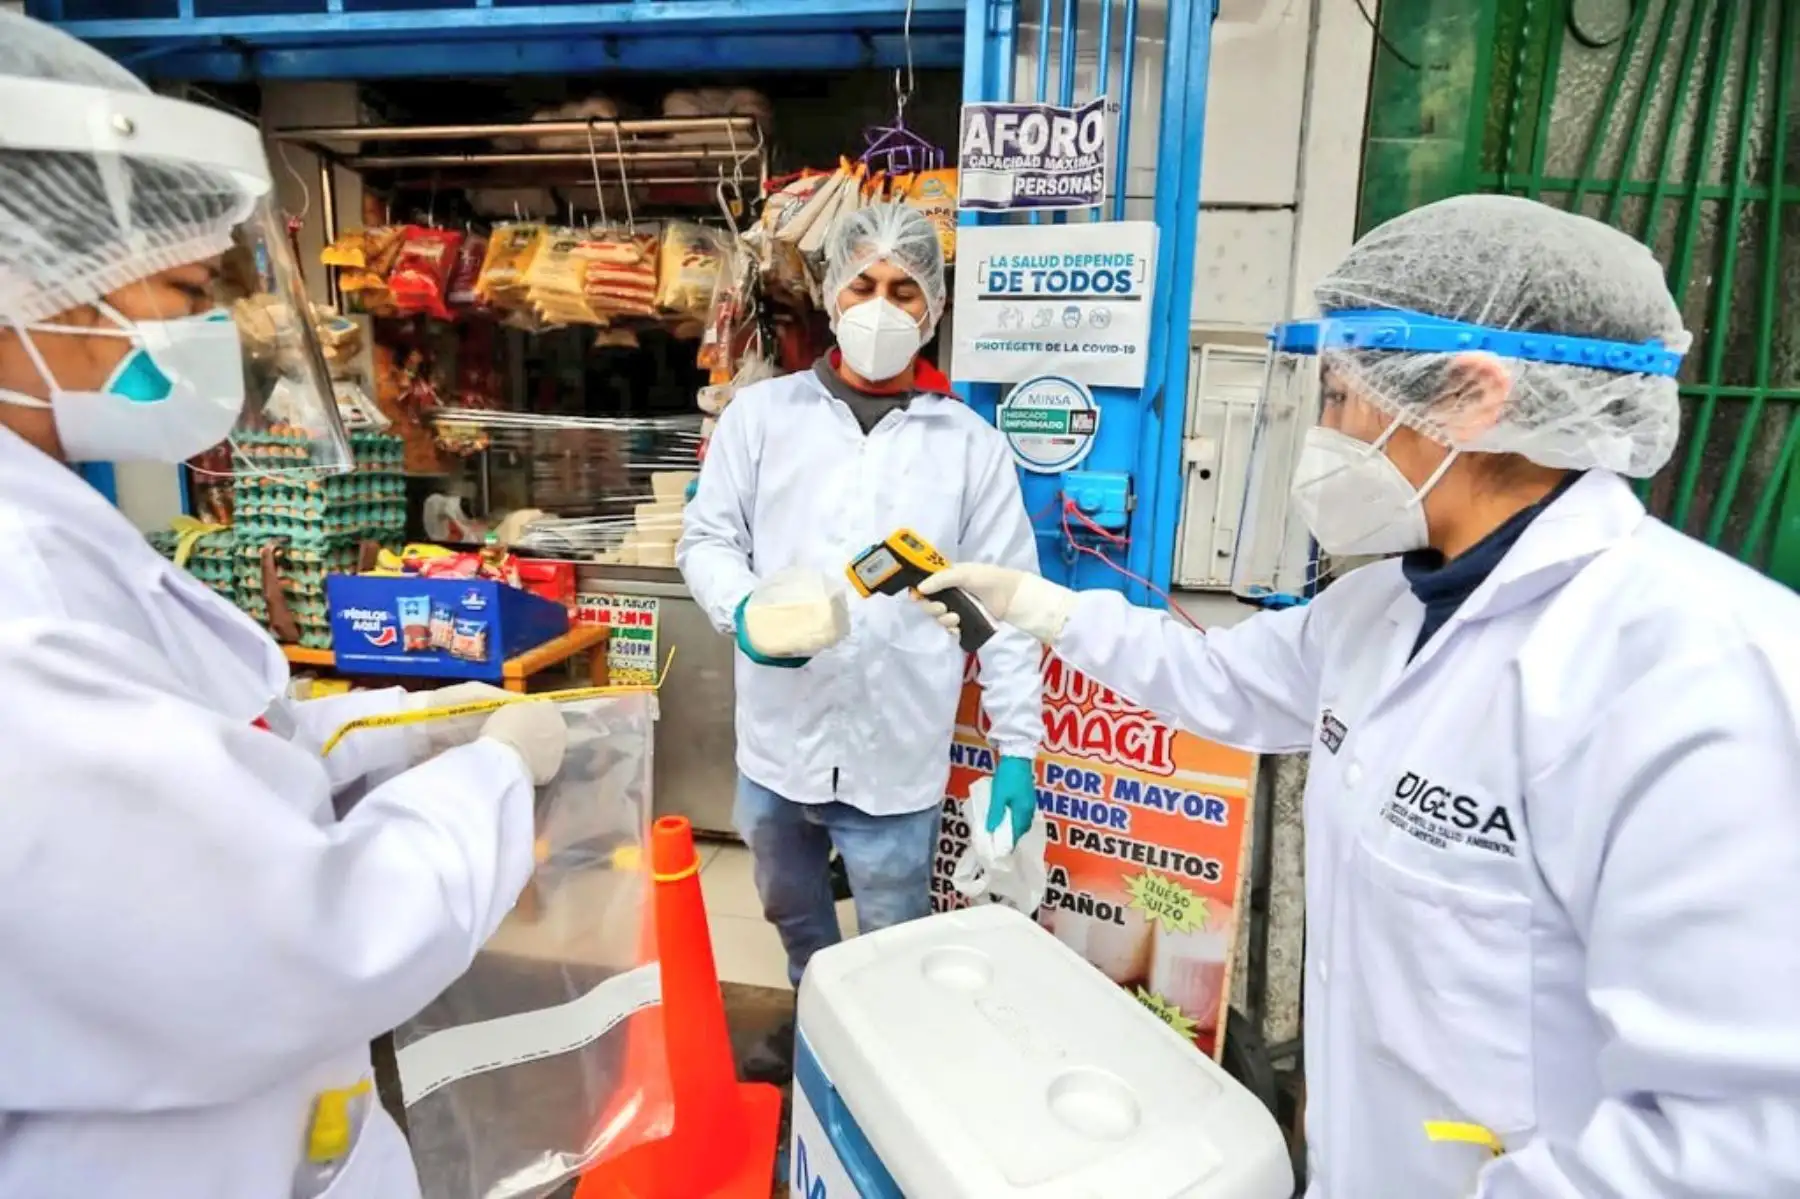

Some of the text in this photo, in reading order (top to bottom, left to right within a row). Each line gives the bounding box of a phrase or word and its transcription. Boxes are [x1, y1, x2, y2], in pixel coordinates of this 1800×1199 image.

[964, 110, 1103, 157] AFORO
[969, 154, 1041, 169] CAPACIDAD
[1015, 172, 1103, 195] PERSONAS
[990, 253, 1135, 269] LA SALUD DEPENDE
[988, 269, 1133, 293] DE TODOS
[1045, 342, 1061, 352] DE
[1064, 343, 1079, 352] LA
[1082, 343, 1137, 354] COVID-19
[1027, 393, 1072, 405] MINSA
[1004, 420, 1064, 429] INFORMADO
[1046, 764, 1226, 823] POR MAYOR
[1395, 770, 1517, 842] DIGESA
[1036, 789, 1129, 830] MENOR
[1069, 827, 1220, 880] PASTELITOS
[1044, 887, 1125, 926] PAÑOL
[1142, 893, 1184, 922] SUIZO
[1144, 878, 1191, 909] QUESO
